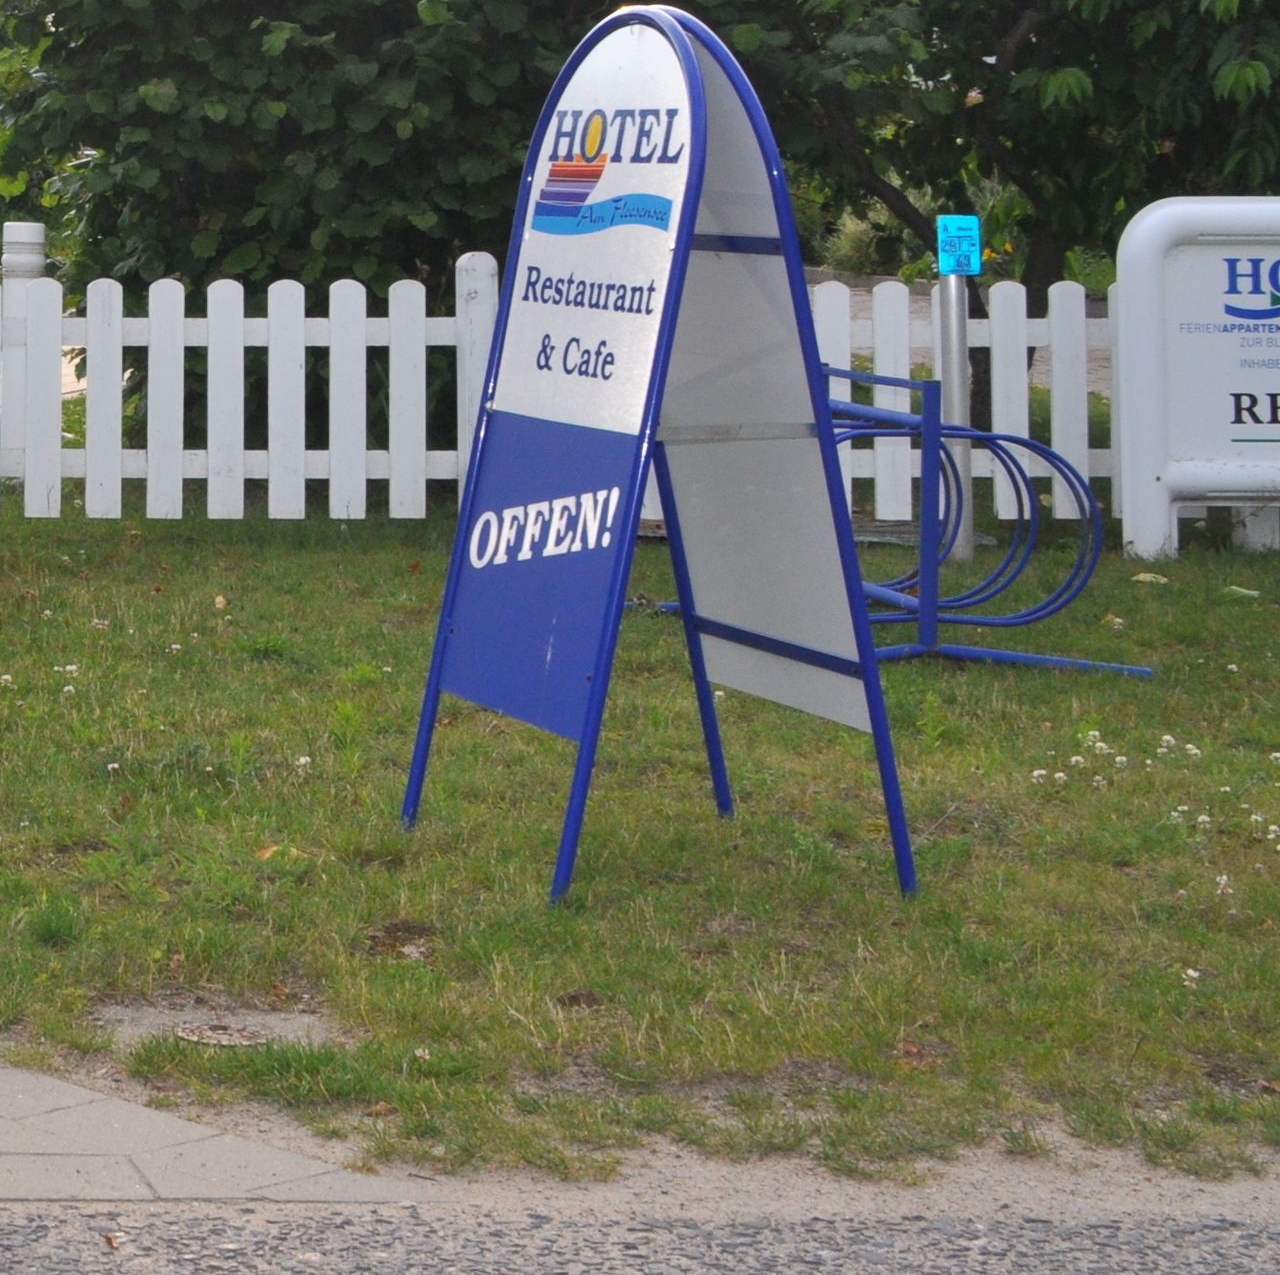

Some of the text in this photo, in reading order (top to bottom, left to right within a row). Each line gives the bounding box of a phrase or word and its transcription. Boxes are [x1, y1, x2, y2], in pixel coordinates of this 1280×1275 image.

[549, 108, 684, 163] HOTEL
[522, 265, 656, 315] Restaurant
[536, 333, 615, 380] & Cafe
[469, 486, 620, 569] OFFEN!
